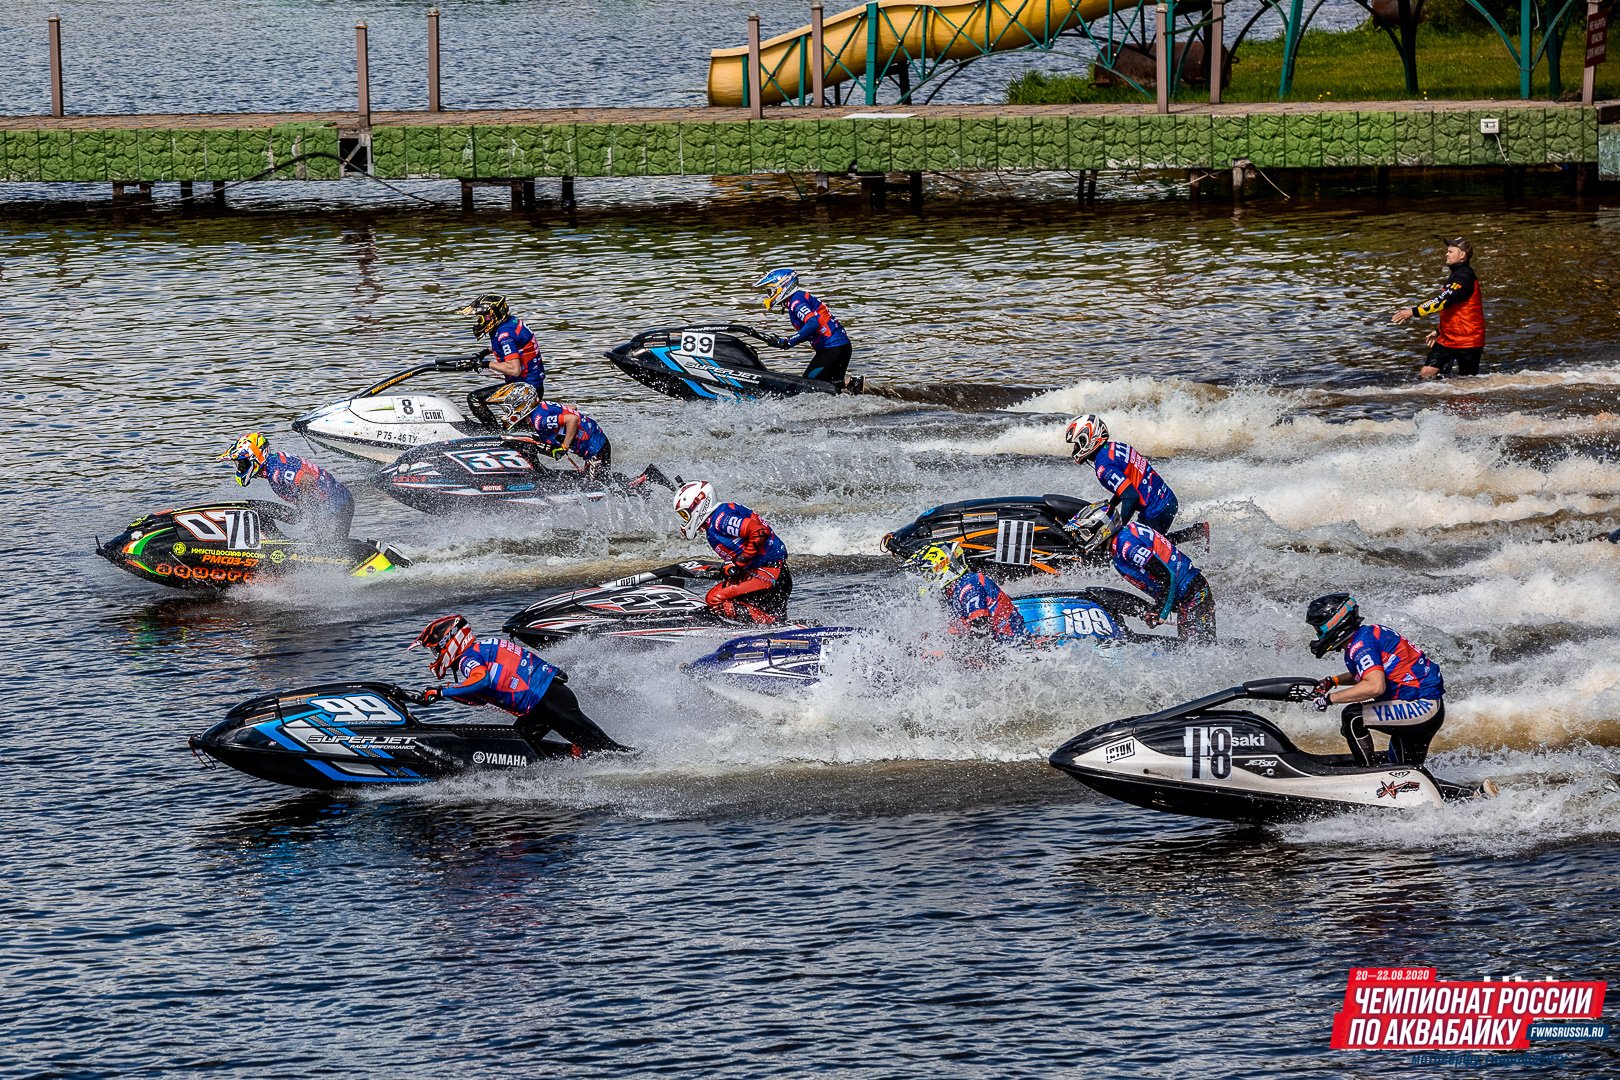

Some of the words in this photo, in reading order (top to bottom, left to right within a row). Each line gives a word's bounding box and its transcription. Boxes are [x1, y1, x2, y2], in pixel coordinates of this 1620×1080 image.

[796, 305, 812, 321] 35
[502, 344, 512, 356] 8
[682, 335, 713, 354] 89
[402, 399, 414, 415] 8
[457, 450, 533, 469] 33
[225, 511, 260, 549] 70
[726, 516, 743, 537] 22
[609, 591, 699, 613] 22
[1064, 608, 1113, 636] 199
[309, 695, 403, 721] 99
[1372, 699, 1434, 721] YAMAHA
[308, 736, 417, 744] SUPERJET
[486, 753, 526, 766] YAMAHA
[1192, 728, 1231, 779] 18
